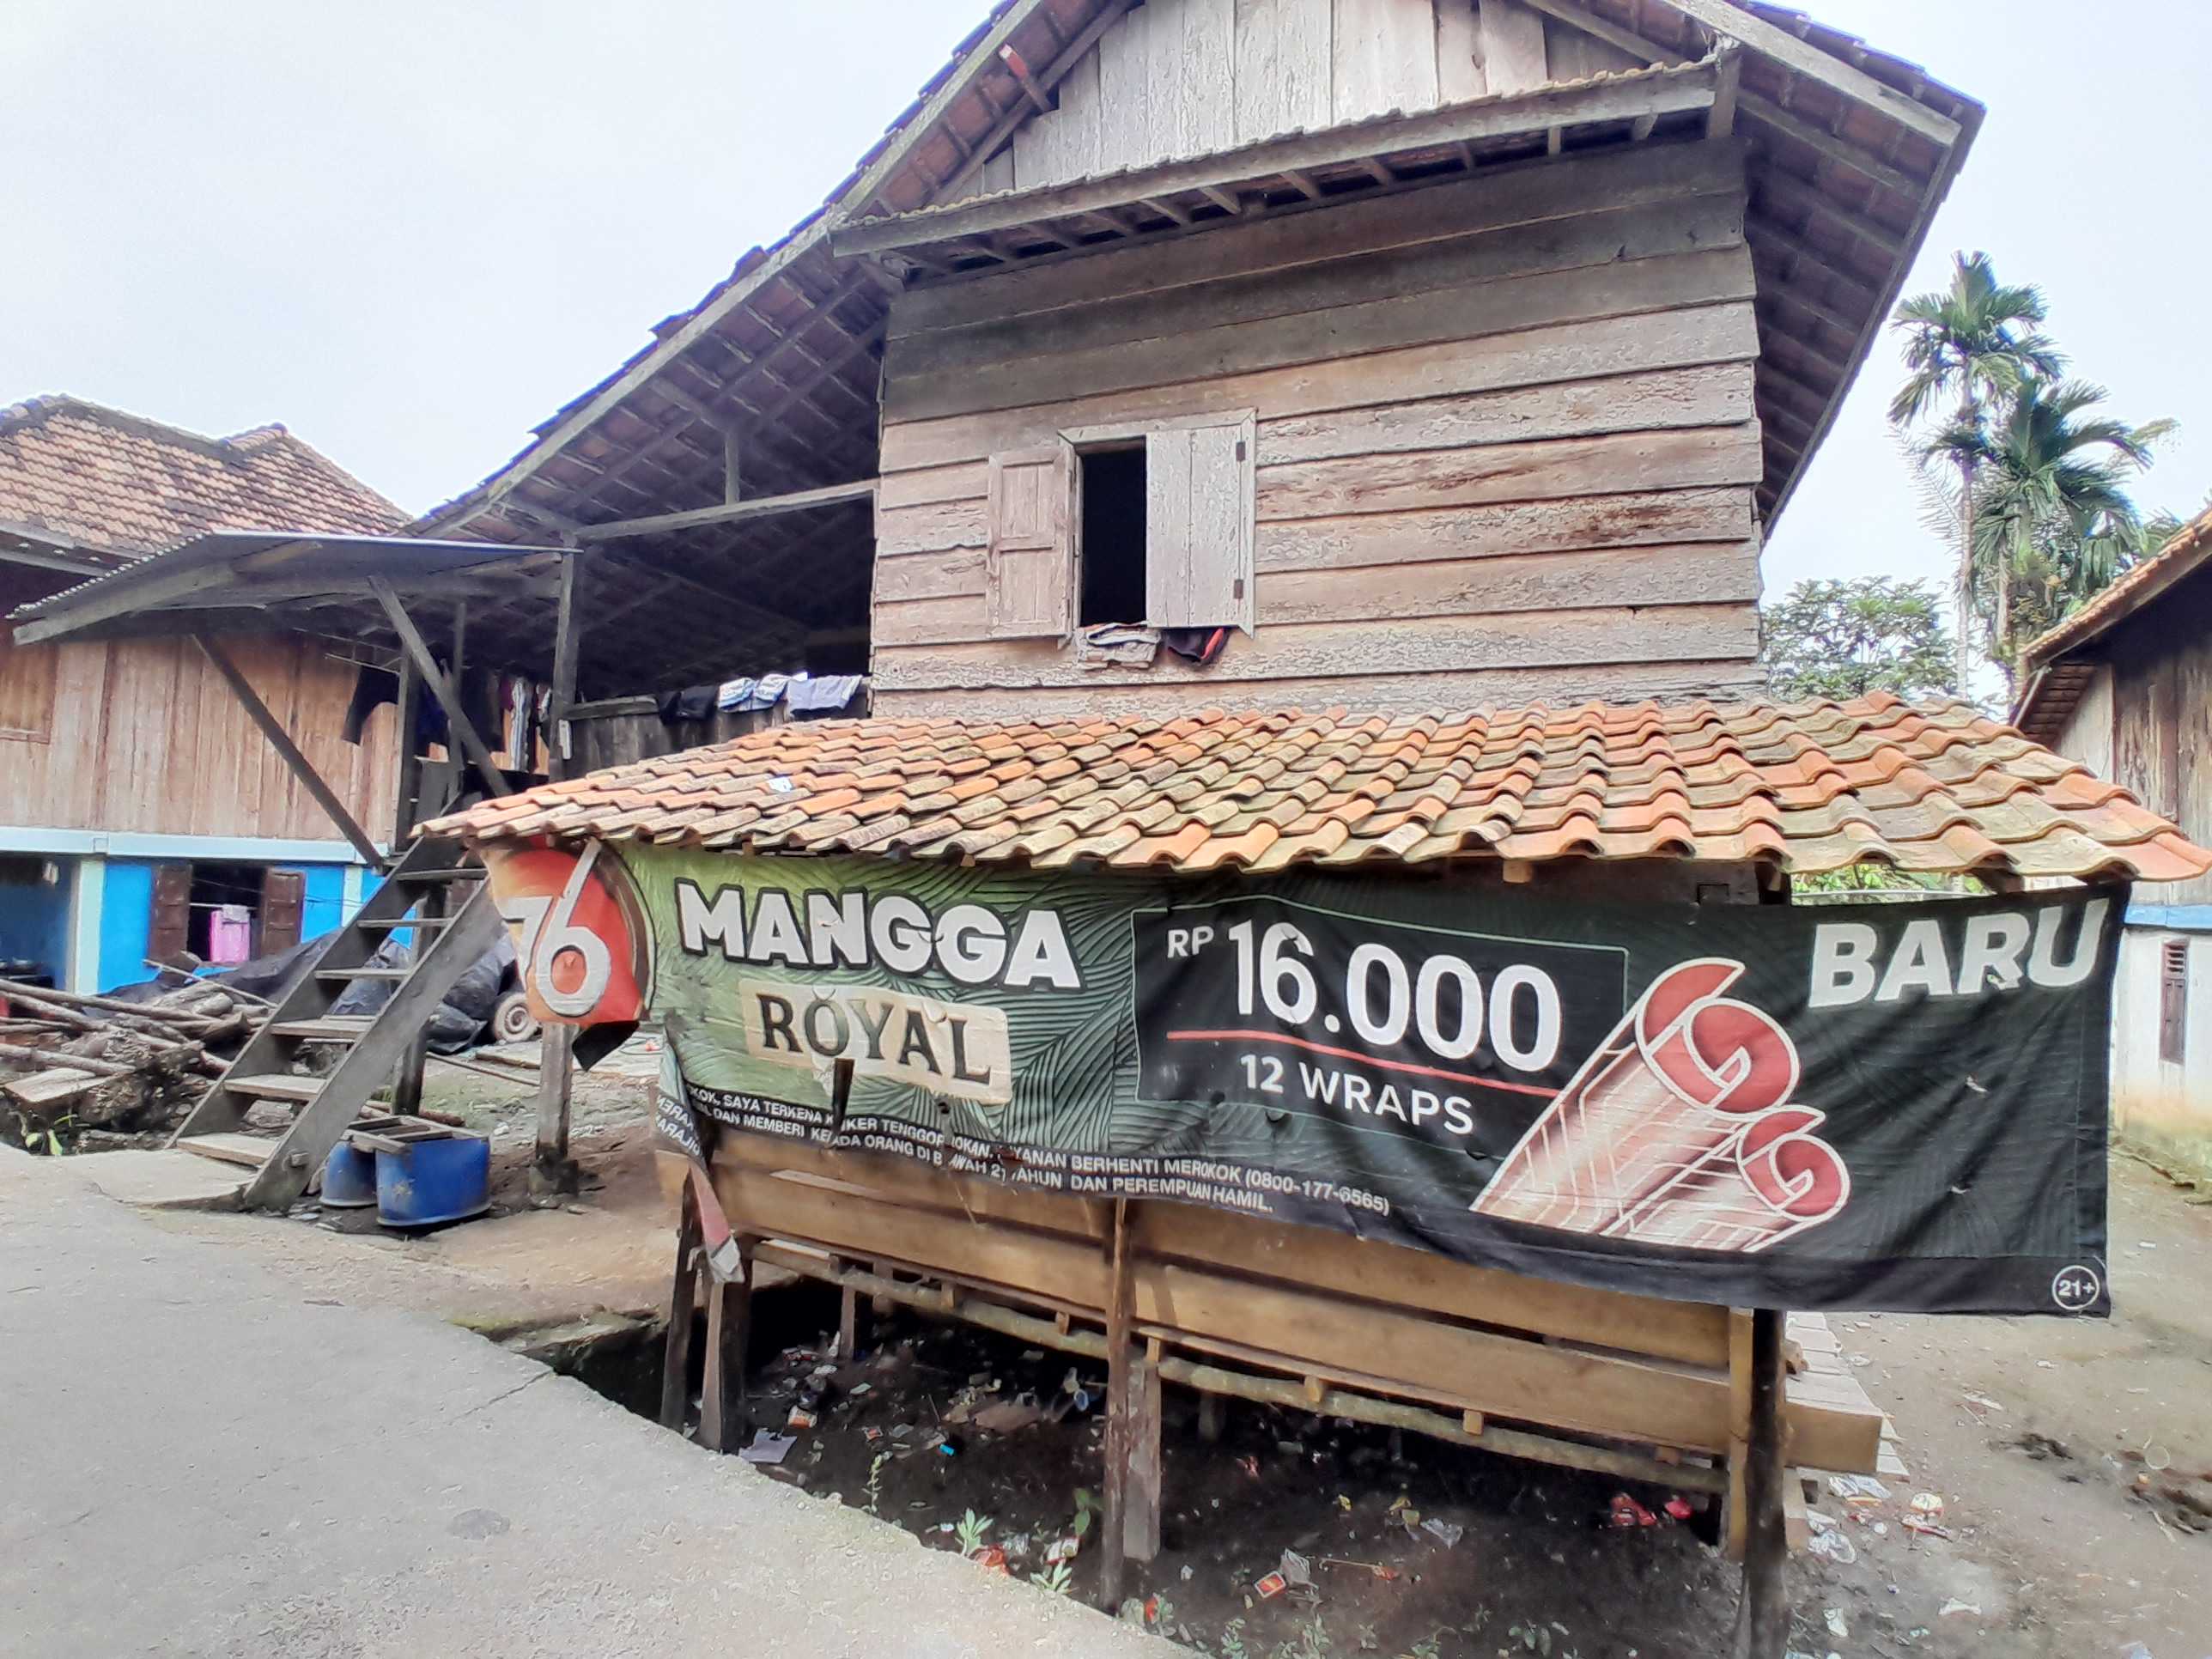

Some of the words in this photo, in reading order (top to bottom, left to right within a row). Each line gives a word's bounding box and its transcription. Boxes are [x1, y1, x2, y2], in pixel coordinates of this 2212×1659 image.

[502, 836, 612, 1017] 76
[675, 879, 1081, 990] MANGGA
[1808, 897, 2110, 1009] BARU
[756, 991, 994, 1085] ROYAL
[1167, 926, 1214, 958] RP
[1228, 919, 1561, 1073] 16.000
[1240, 1054, 1285, 1094] 12
[1298, 1061, 1474, 1134] WRAPS
[713, 1108, 741, 1126] DAN
[743, 1114, 805, 1138] MEMBERI
[864, 1133, 915, 1158] ORANG
[916, 1145, 931, 1162] DI
[1070, 1175, 1109, 1194] DAN
[1112, 1177, 1212, 1201] PEREMPUAN
[1212, 1188, 1273, 1213] HAMIL.
[722, 1094, 761, 1113] SAYA
[763, 1100, 823, 1124] TERKENA
[825, 1114, 878, 1132] KKER
[997, 1145, 1067, 1169] YANAN
[1071, 1154, 1159, 1175] BERHENTI
[1164, 1158, 1242, 1184] MEROKOK
[1245, 1168, 1391, 1217] (0800-177-6565)
[2057, 1279, 2096, 1298] 21+
